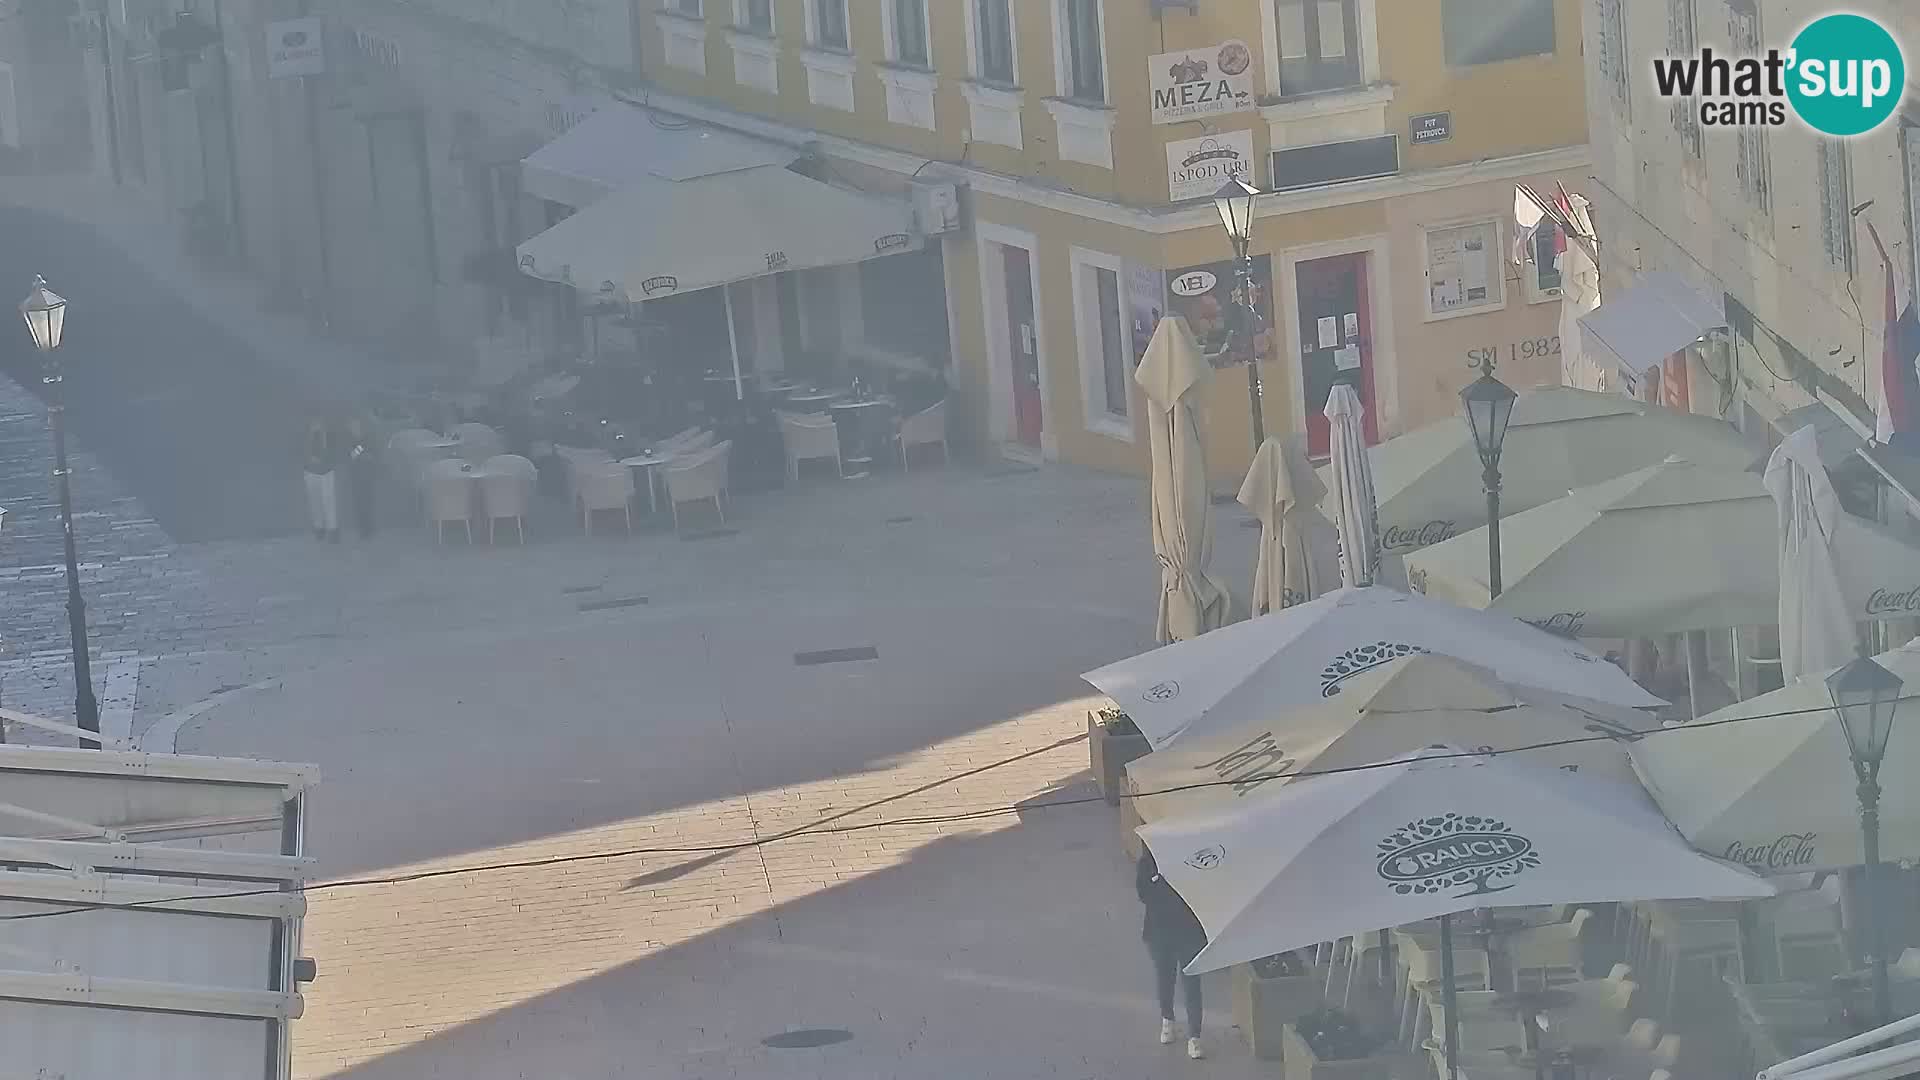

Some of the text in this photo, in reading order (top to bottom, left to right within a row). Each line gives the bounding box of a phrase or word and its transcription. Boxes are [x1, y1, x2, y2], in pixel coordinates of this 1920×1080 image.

[1154, 79, 1233, 109] MEZA
[1425, 118, 1436, 127] PUT
[1173, 165, 1219, 183] ISPOD
[1511, 336, 1561, 361] 1982
[1416, 839, 1515, 869] RAUCH
[1724, 831, 1816, 868] Coca-Cola
